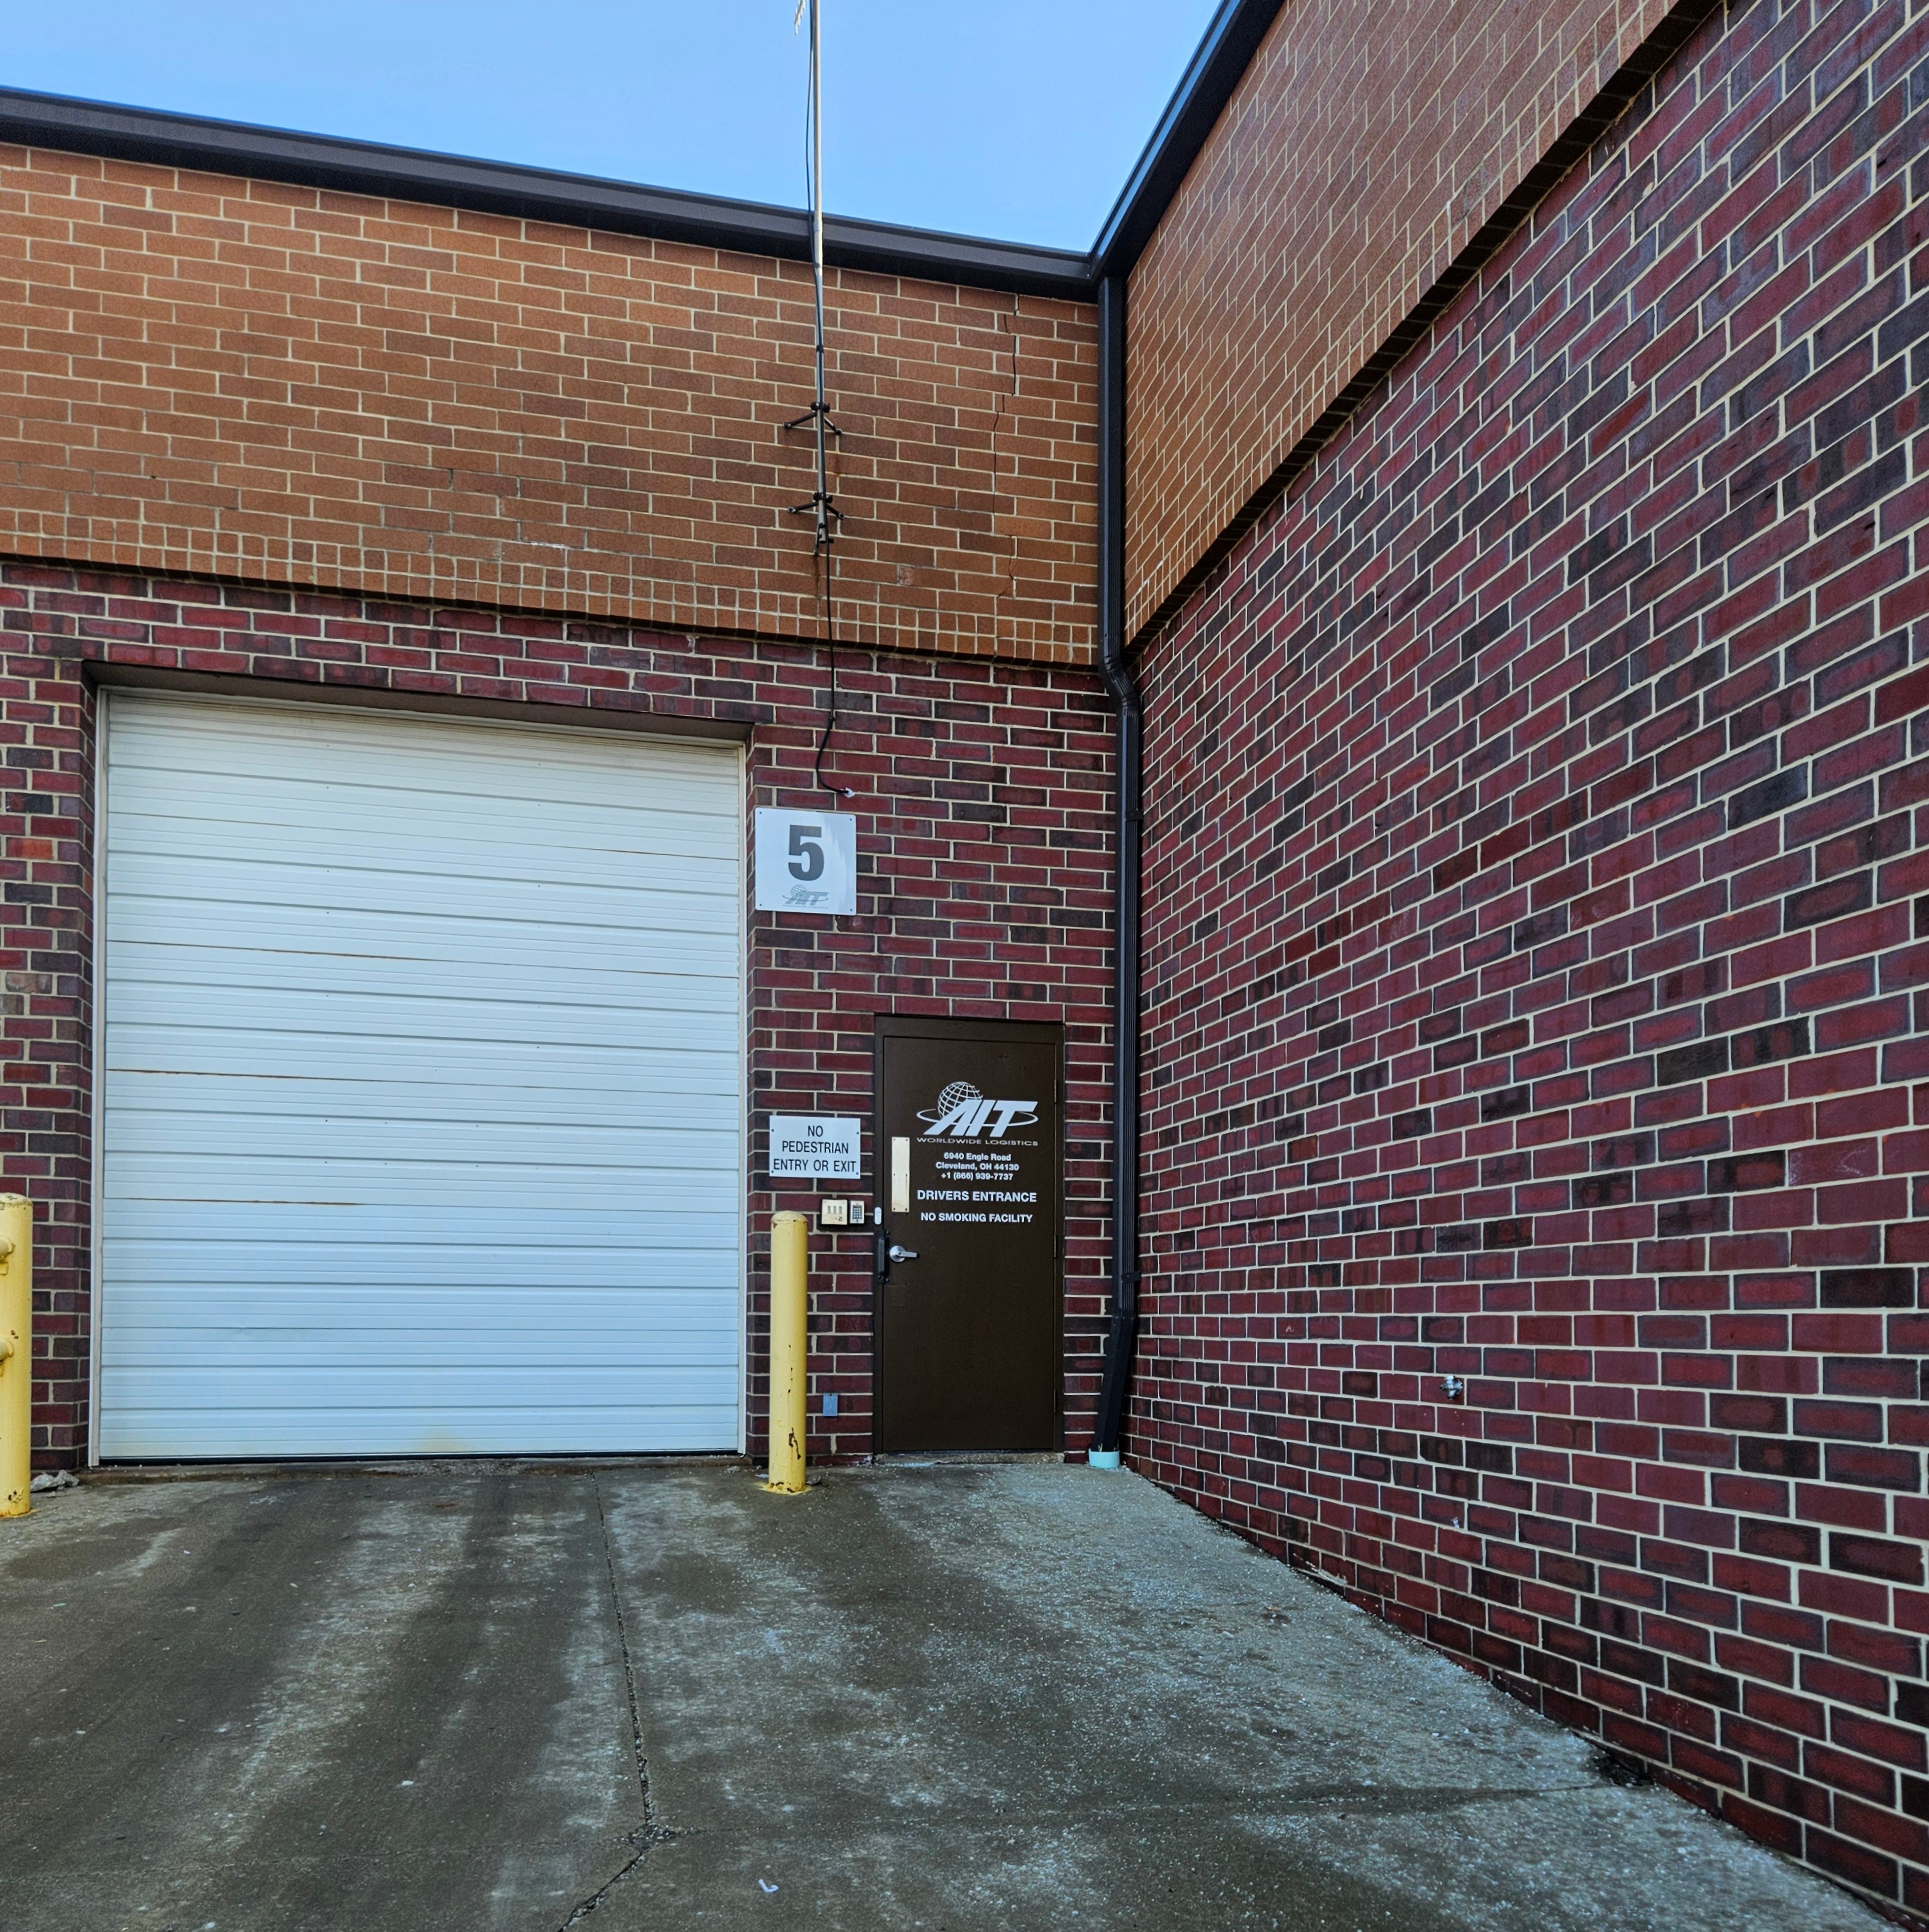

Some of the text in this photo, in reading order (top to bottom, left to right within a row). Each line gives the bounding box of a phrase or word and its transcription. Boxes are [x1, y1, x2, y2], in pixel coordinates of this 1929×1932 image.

[788, 824, 825, 881] 5
[785, 890, 828, 906] AIT
[923, 1099, 1038, 1137] AIT
[808, 1126, 823, 1137] NO
[782, 1140, 849, 1154] PEDESTRIAN
[966, 1153, 989, 1162] Engle
[773, 1158, 857, 1172] ENTRY OR EXIT
[936, 1162, 978, 1170] Cleveland,
[953, 1172, 973, 1180] (866)
[917, 1190, 1037, 1202] DRIVERS ENTRANCE
[921, 1212, 1032, 1223] NO SMOKING FACILITY
